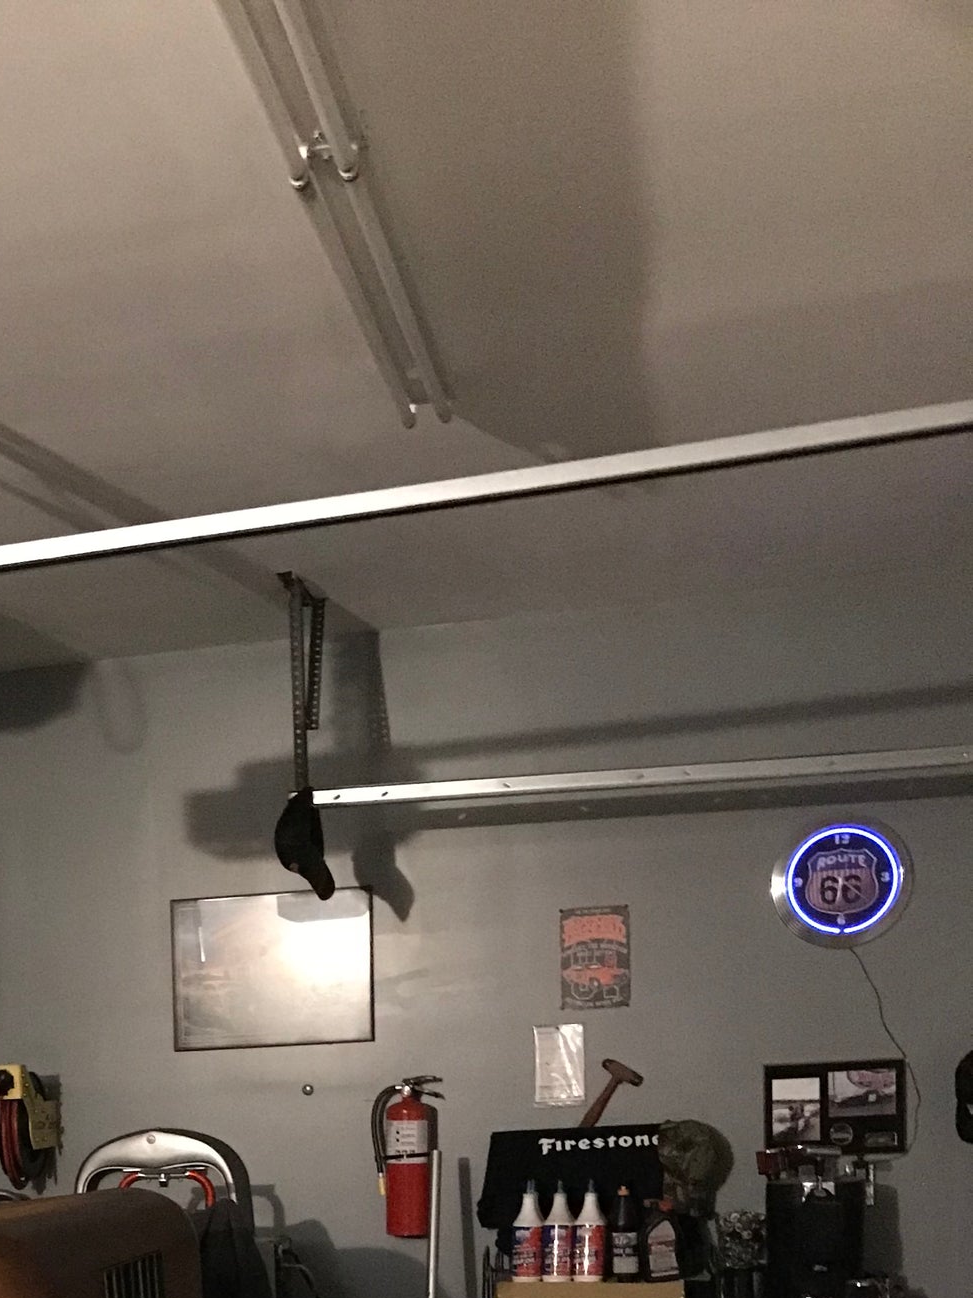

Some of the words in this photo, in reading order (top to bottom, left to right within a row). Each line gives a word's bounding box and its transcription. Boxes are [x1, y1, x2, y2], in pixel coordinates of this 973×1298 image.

[834, 833, 851, 845] 12
[817, 854, 867, 869] ROUTE
[880, 872, 891, 882] 3
[820, 874, 862, 905] 66
